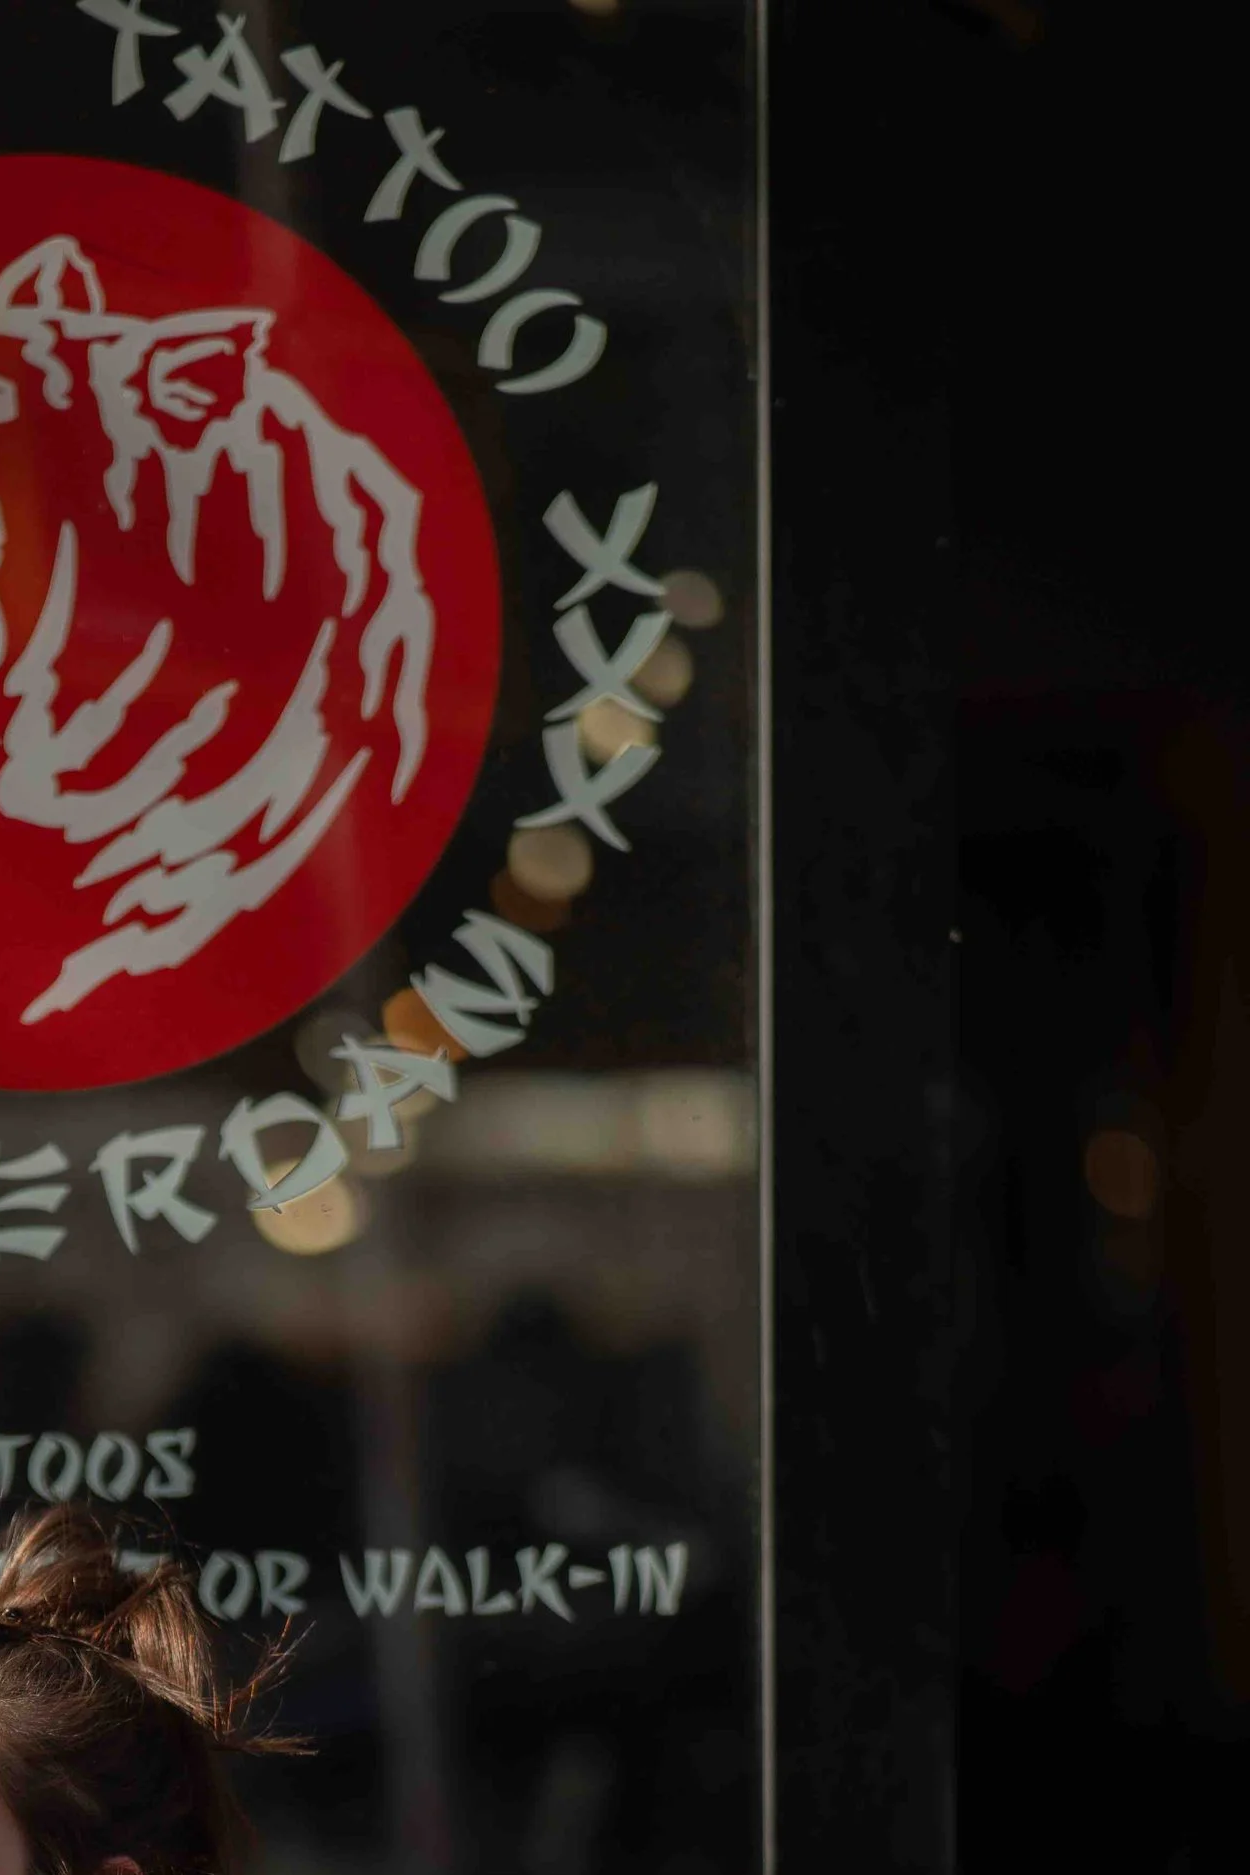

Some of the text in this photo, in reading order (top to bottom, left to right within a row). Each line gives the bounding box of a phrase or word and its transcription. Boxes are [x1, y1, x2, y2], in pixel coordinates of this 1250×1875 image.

[75, 0, 609, 393] TATTOO
[197, 1549, 312, 1622] OR
[340, 1541, 690, 1623] WALK-IN
